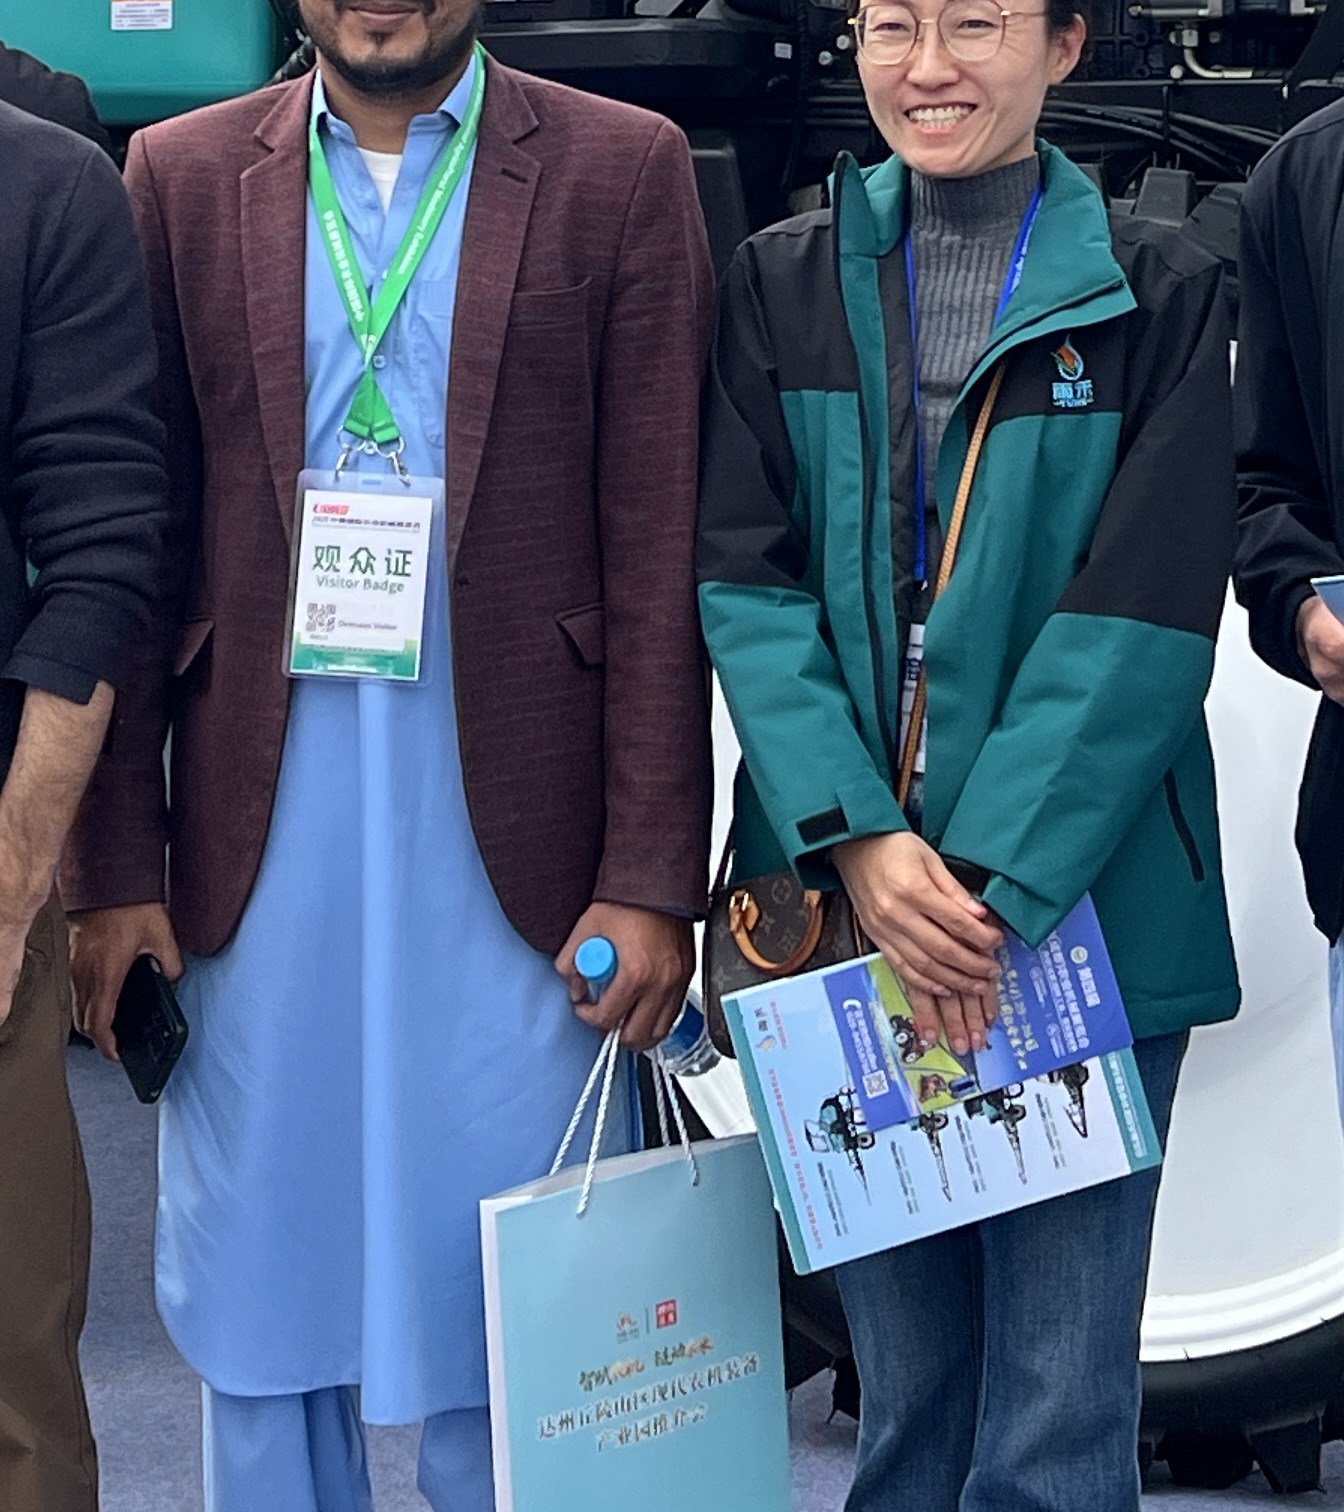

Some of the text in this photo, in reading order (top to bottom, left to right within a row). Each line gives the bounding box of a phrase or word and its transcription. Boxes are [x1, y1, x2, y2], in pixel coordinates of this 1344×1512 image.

[312, 544, 413, 578] 观众证
[316, 574, 406, 595] Visitor Badge
